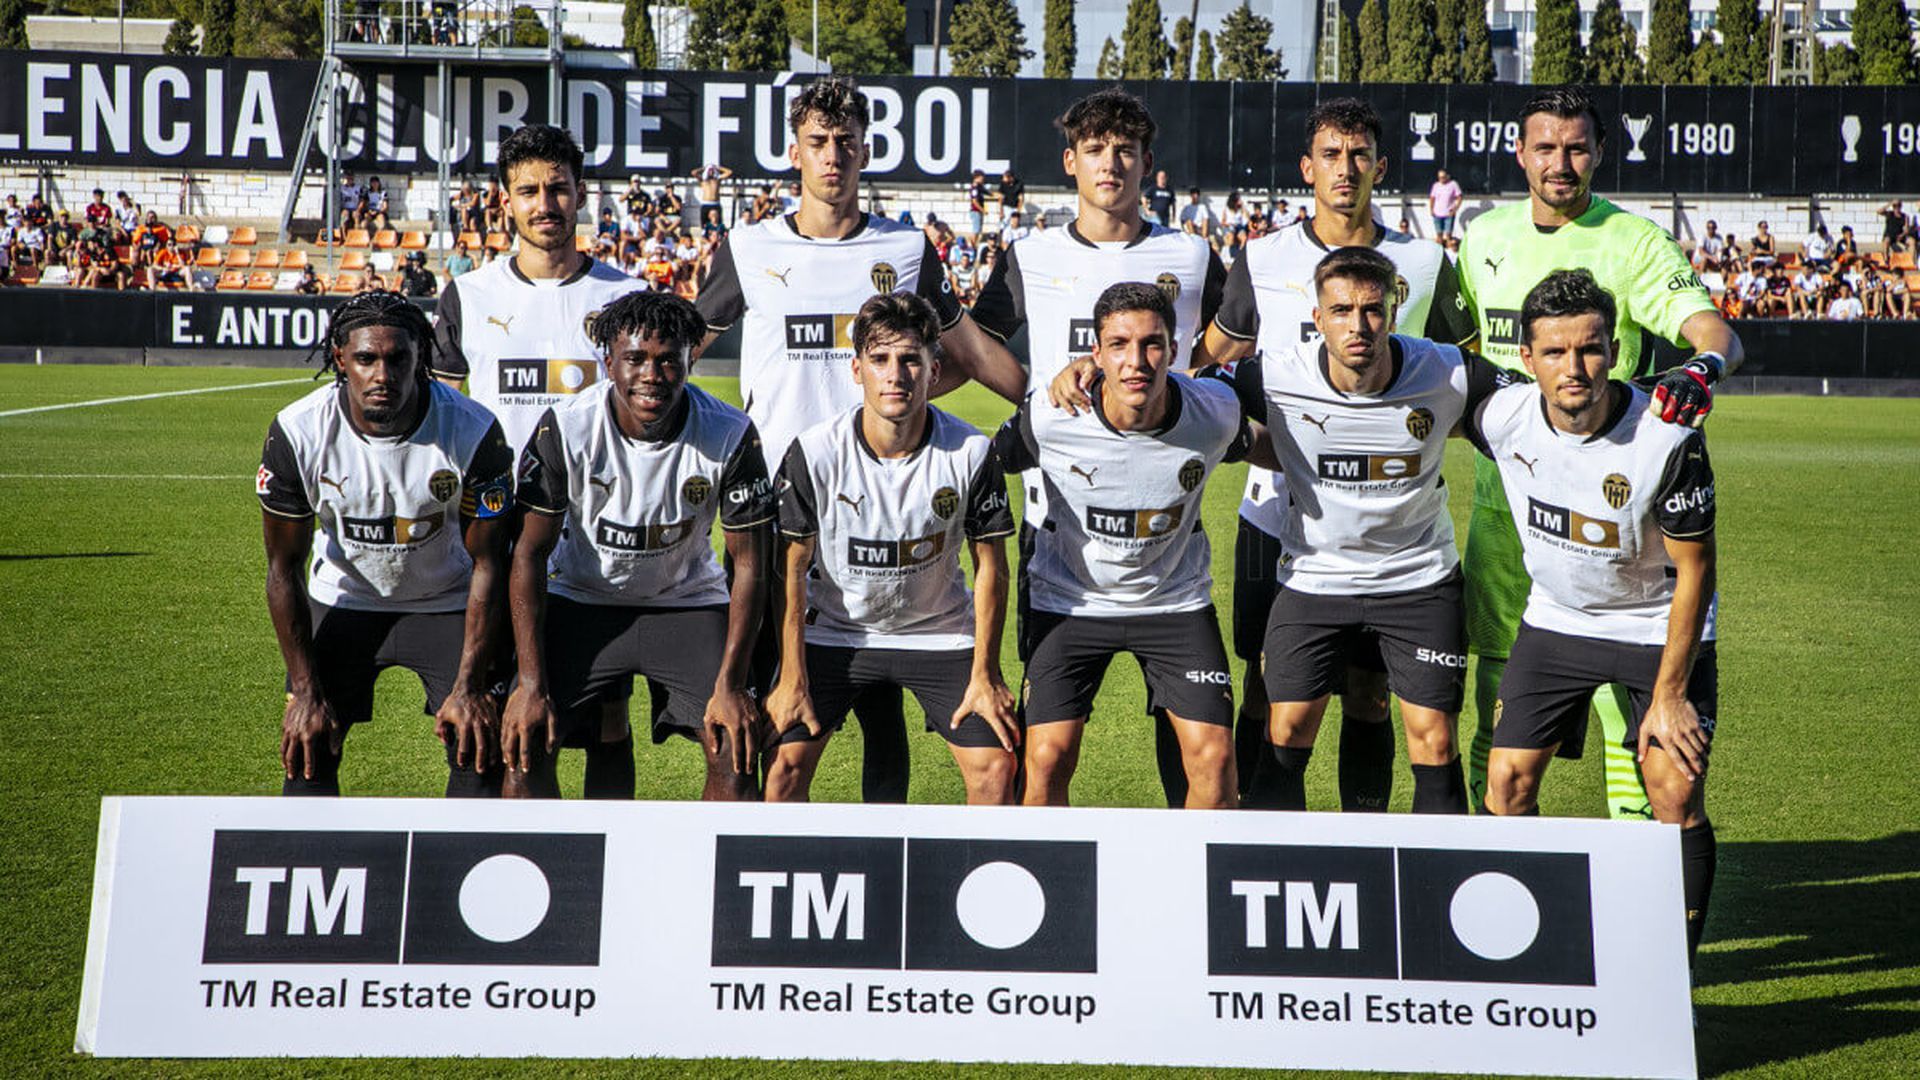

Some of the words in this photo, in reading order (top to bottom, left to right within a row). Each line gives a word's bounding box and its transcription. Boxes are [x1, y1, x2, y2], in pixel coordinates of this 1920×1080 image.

[318, 71, 532, 165] CLUB
[567, 80, 668, 168] DE
[703, 72, 1010, 175] FÚBOL
[1454, 121, 1518, 153] 1979
[1668, 122, 1735, 155] 1980
[172, 305, 203, 343] E.
[216, 306, 332, 346] ANTON
[791, 323, 824, 342] TM
[1488, 318, 1513, 337] TM
[803, 352, 823, 360] Real
[504, 367, 538, 387] TM
[514, 396, 535, 405] Real
[1323, 461, 1359, 476] TM
[1092, 513, 1127, 532] TM
[1533, 506, 1562, 532] TM
[348, 523, 384, 540] TM
[604, 526, 638, 546] TM
[854, 544, 889, 563] TM
[1561, 542, 1590, 556] Estate
[235, 867, 367, 936] TM
[739, 871, 866, 940] TM
[1231, 880, 1360, 950] TM
[200, 980, 257, 1008] TM
[270, 979, 348, 1008] Real
[361, 981, 472, 1009] Estate
[484, 980, 596, 1016] Group
[710, 983, 765, 1011] TM
[779, 983, 853, 1012] Real
[867, 985, 974, 1015] Estate
[987, 987, 1096, 1023] Group
[1208, 991, 1263, 1020] TM
[1278, 992, 1351, 1022] Real
[1365, 995, 1473, 1026] Estate
[1486, 999, 1597, 1036] Group
